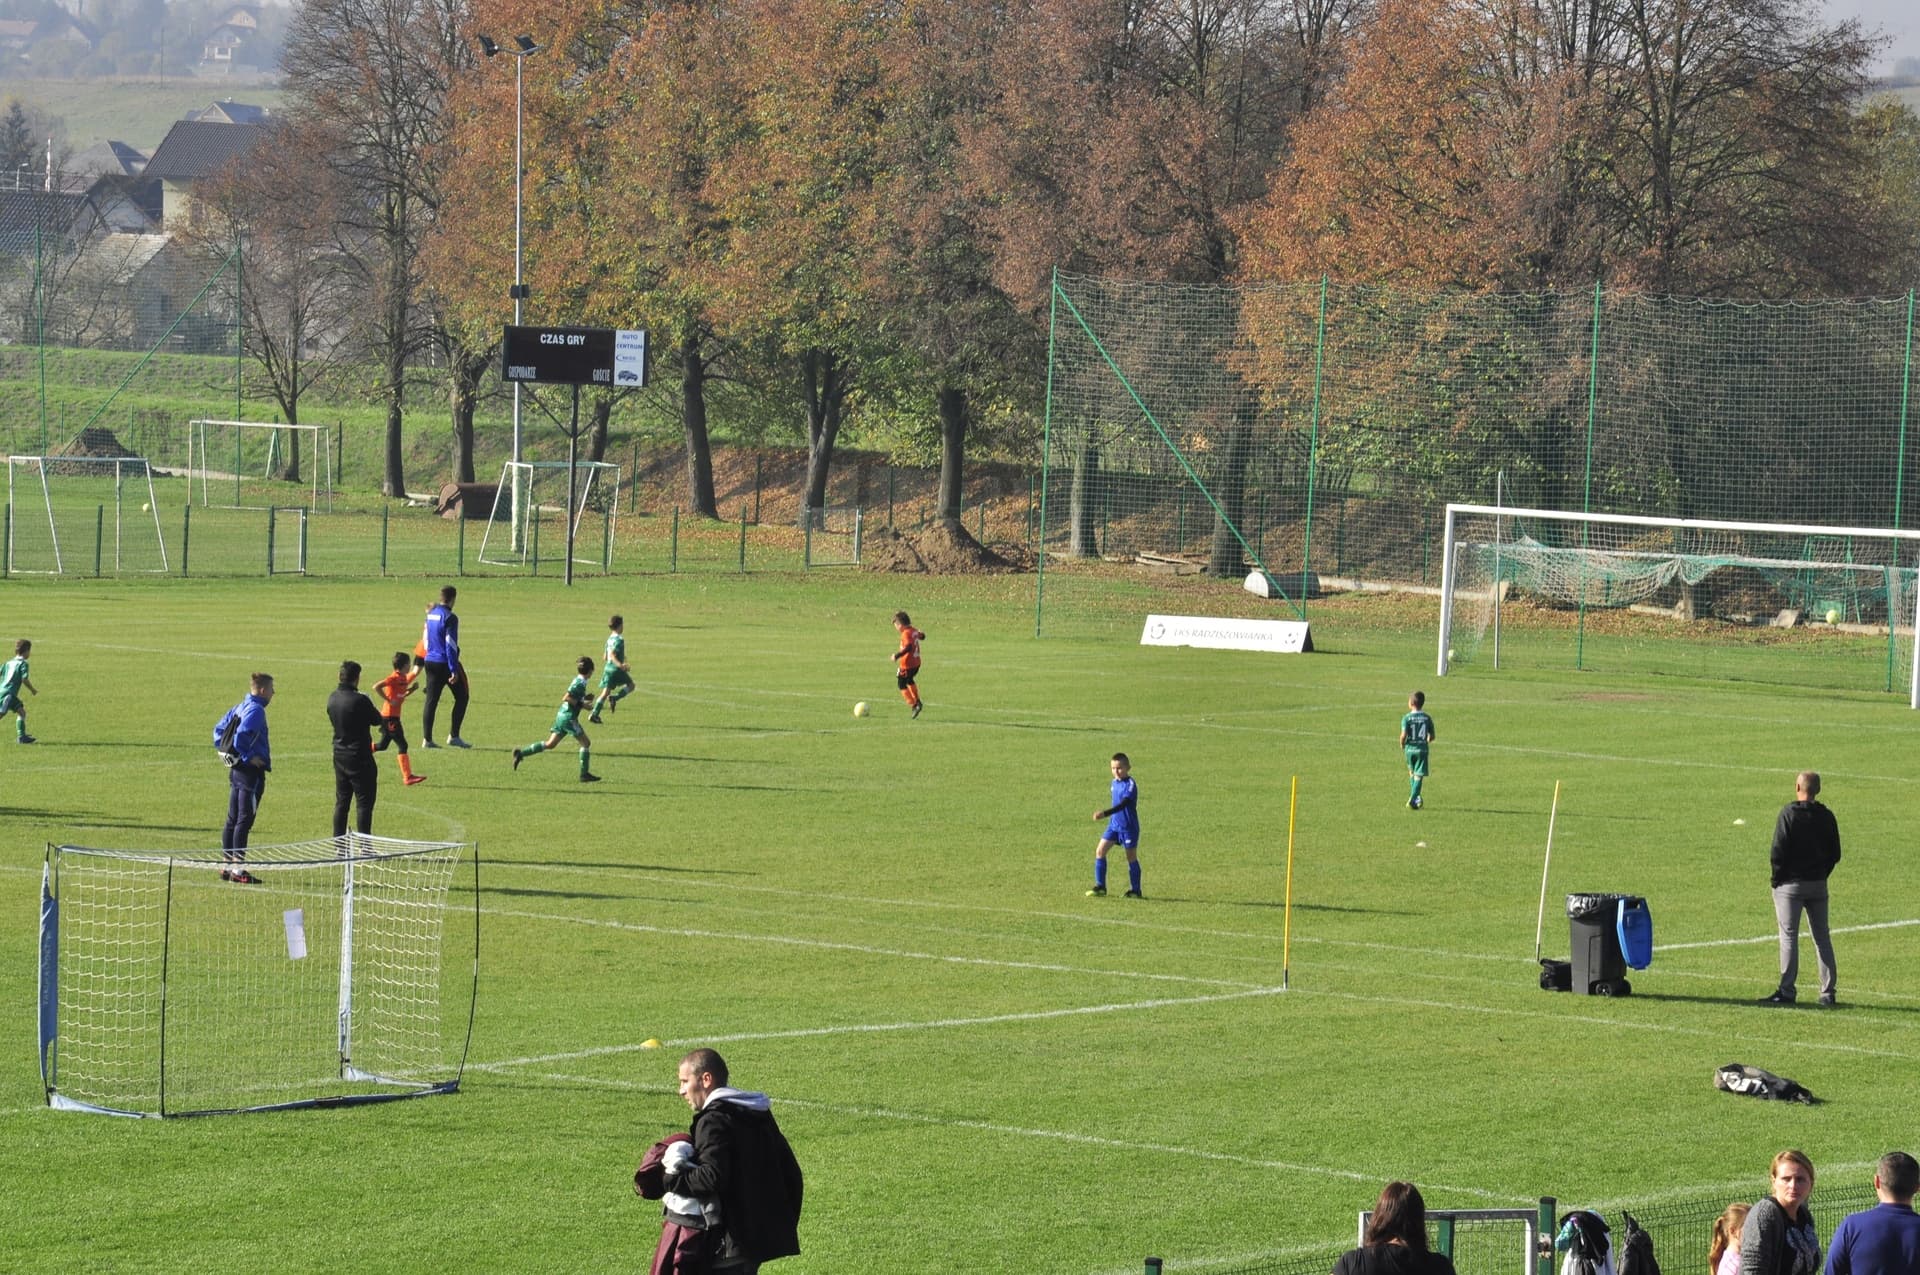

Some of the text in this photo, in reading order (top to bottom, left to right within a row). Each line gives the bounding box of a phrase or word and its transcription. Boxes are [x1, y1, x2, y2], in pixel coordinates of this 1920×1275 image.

[540, 333, 586, 345] CZAS GRY
[1410, 723, 1426, 740] 14
